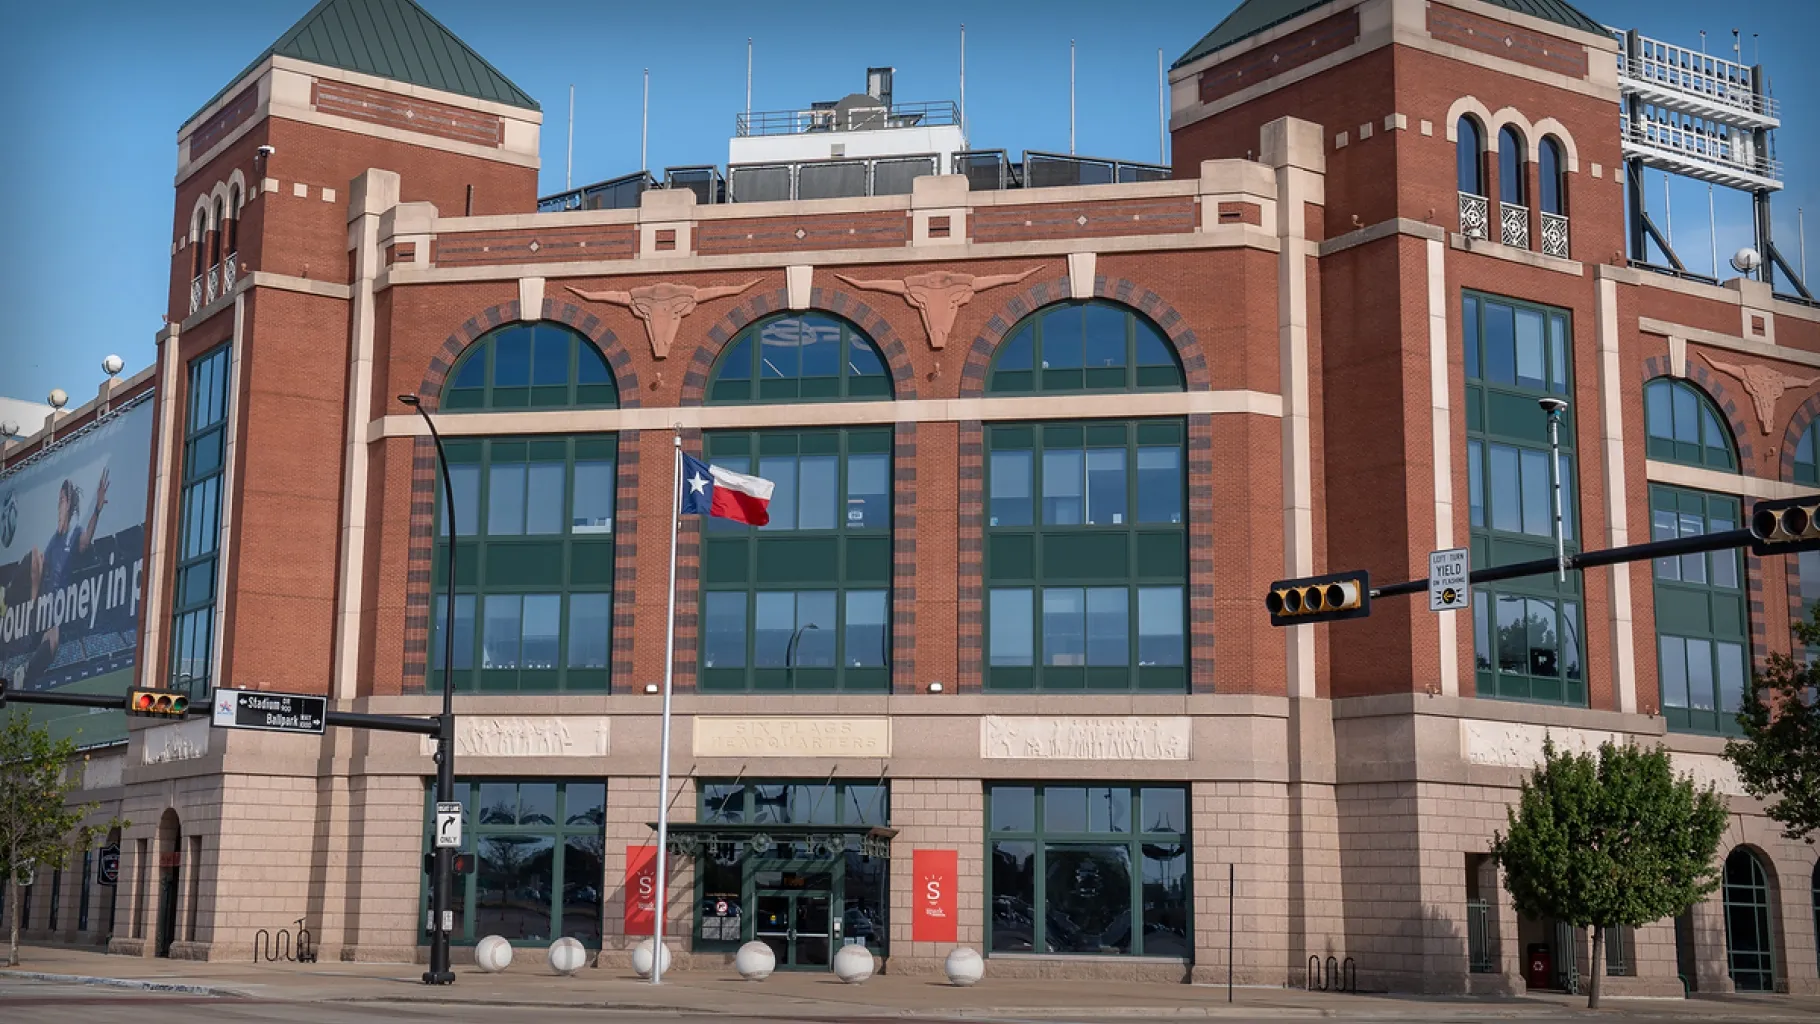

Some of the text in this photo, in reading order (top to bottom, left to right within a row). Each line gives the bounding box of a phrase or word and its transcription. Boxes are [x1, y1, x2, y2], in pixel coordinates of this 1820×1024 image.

[1450, 553, 1463, 561] TURN
[1436, 564, 1460, 576] YIELD
[36, 572, 104, 630] money
[106, 551, 127, 610] in
[248, 696, 280, 711] Stadium
[266, 712, 298, 727] Ballpark
[735, 721, 853, 735] SIX FLAGS
[711, 735, 878, 749] HEADQUARTERS
[439, 836, 457, 844] ONLY
[639, 876, 652, 894] S
[927, 881, 940, 900] S
